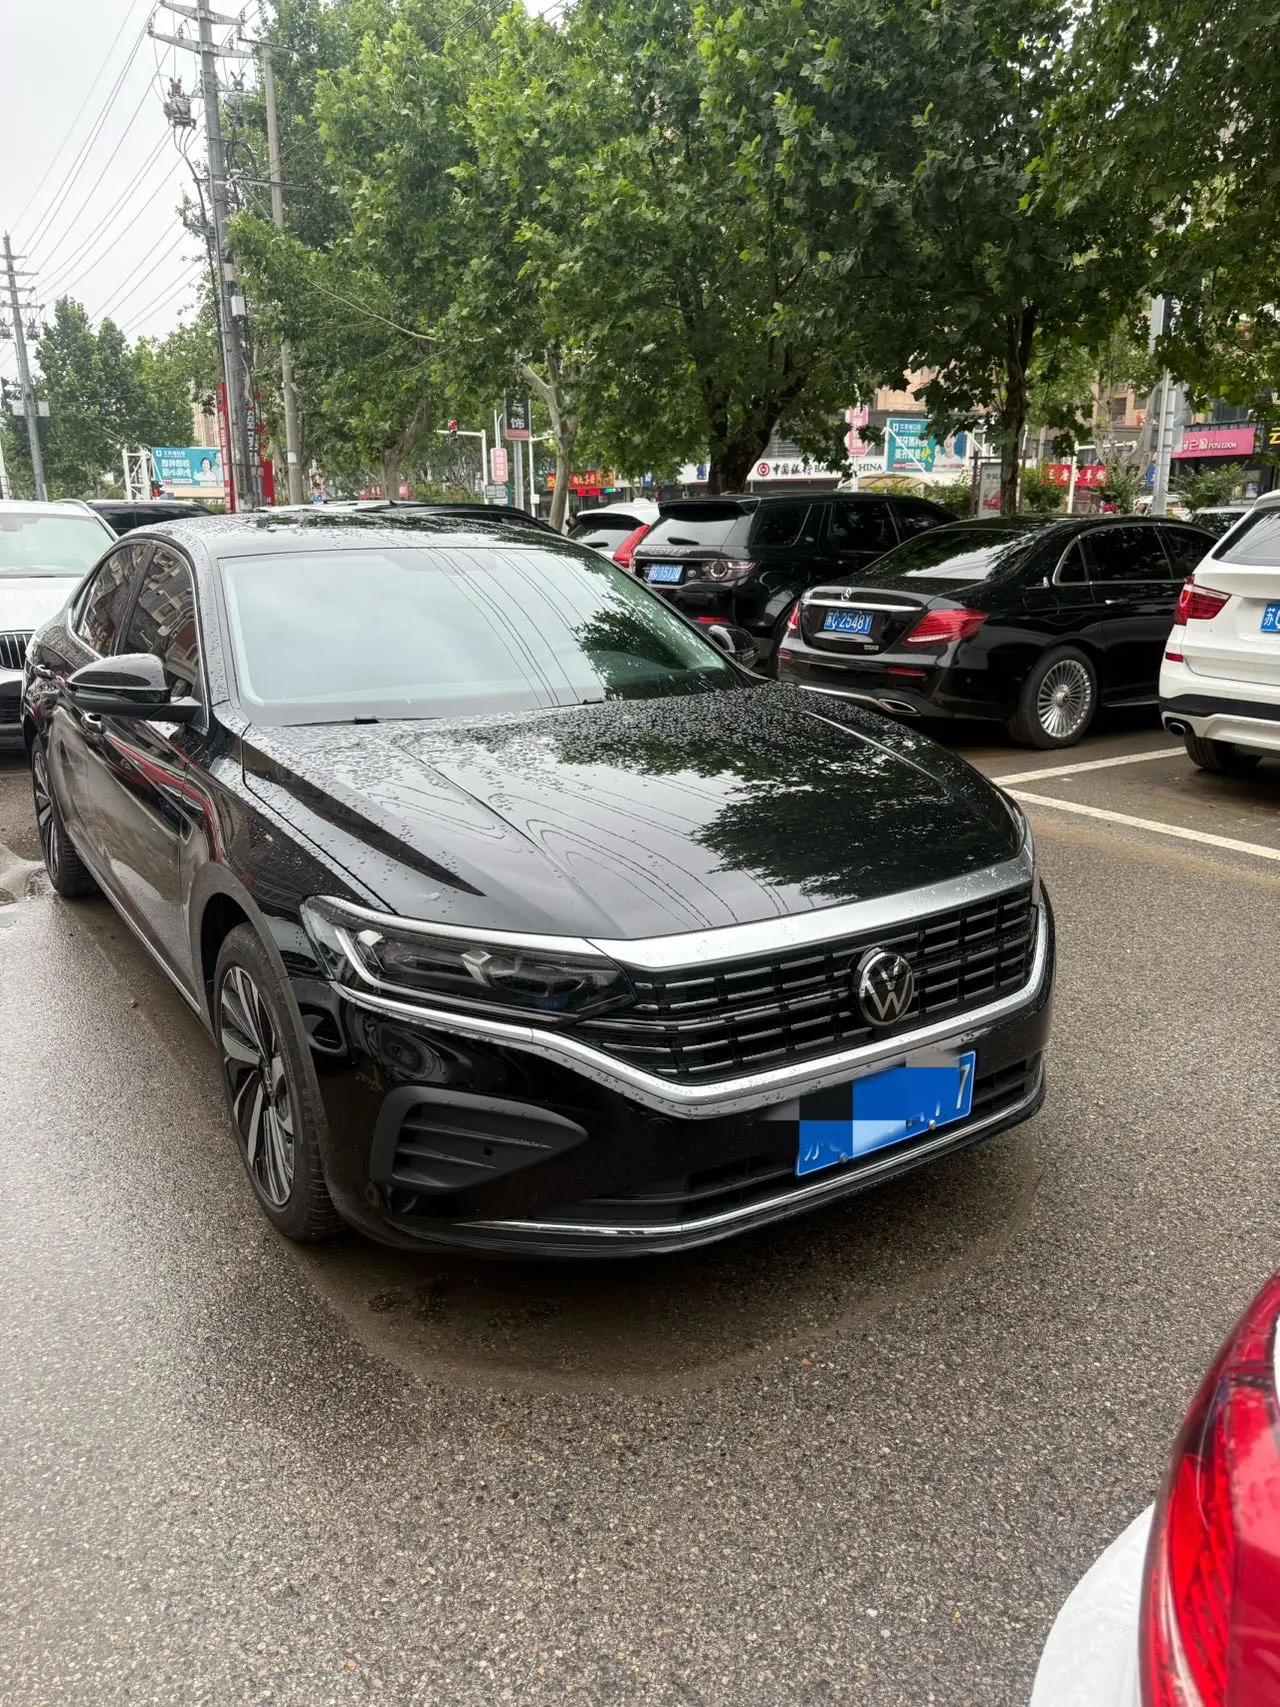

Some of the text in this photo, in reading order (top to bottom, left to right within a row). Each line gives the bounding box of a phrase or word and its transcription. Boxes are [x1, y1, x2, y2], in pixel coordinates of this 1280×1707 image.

[773, 463, 812, 475] 中国银行
[858, 464, 882, 473] HINA
